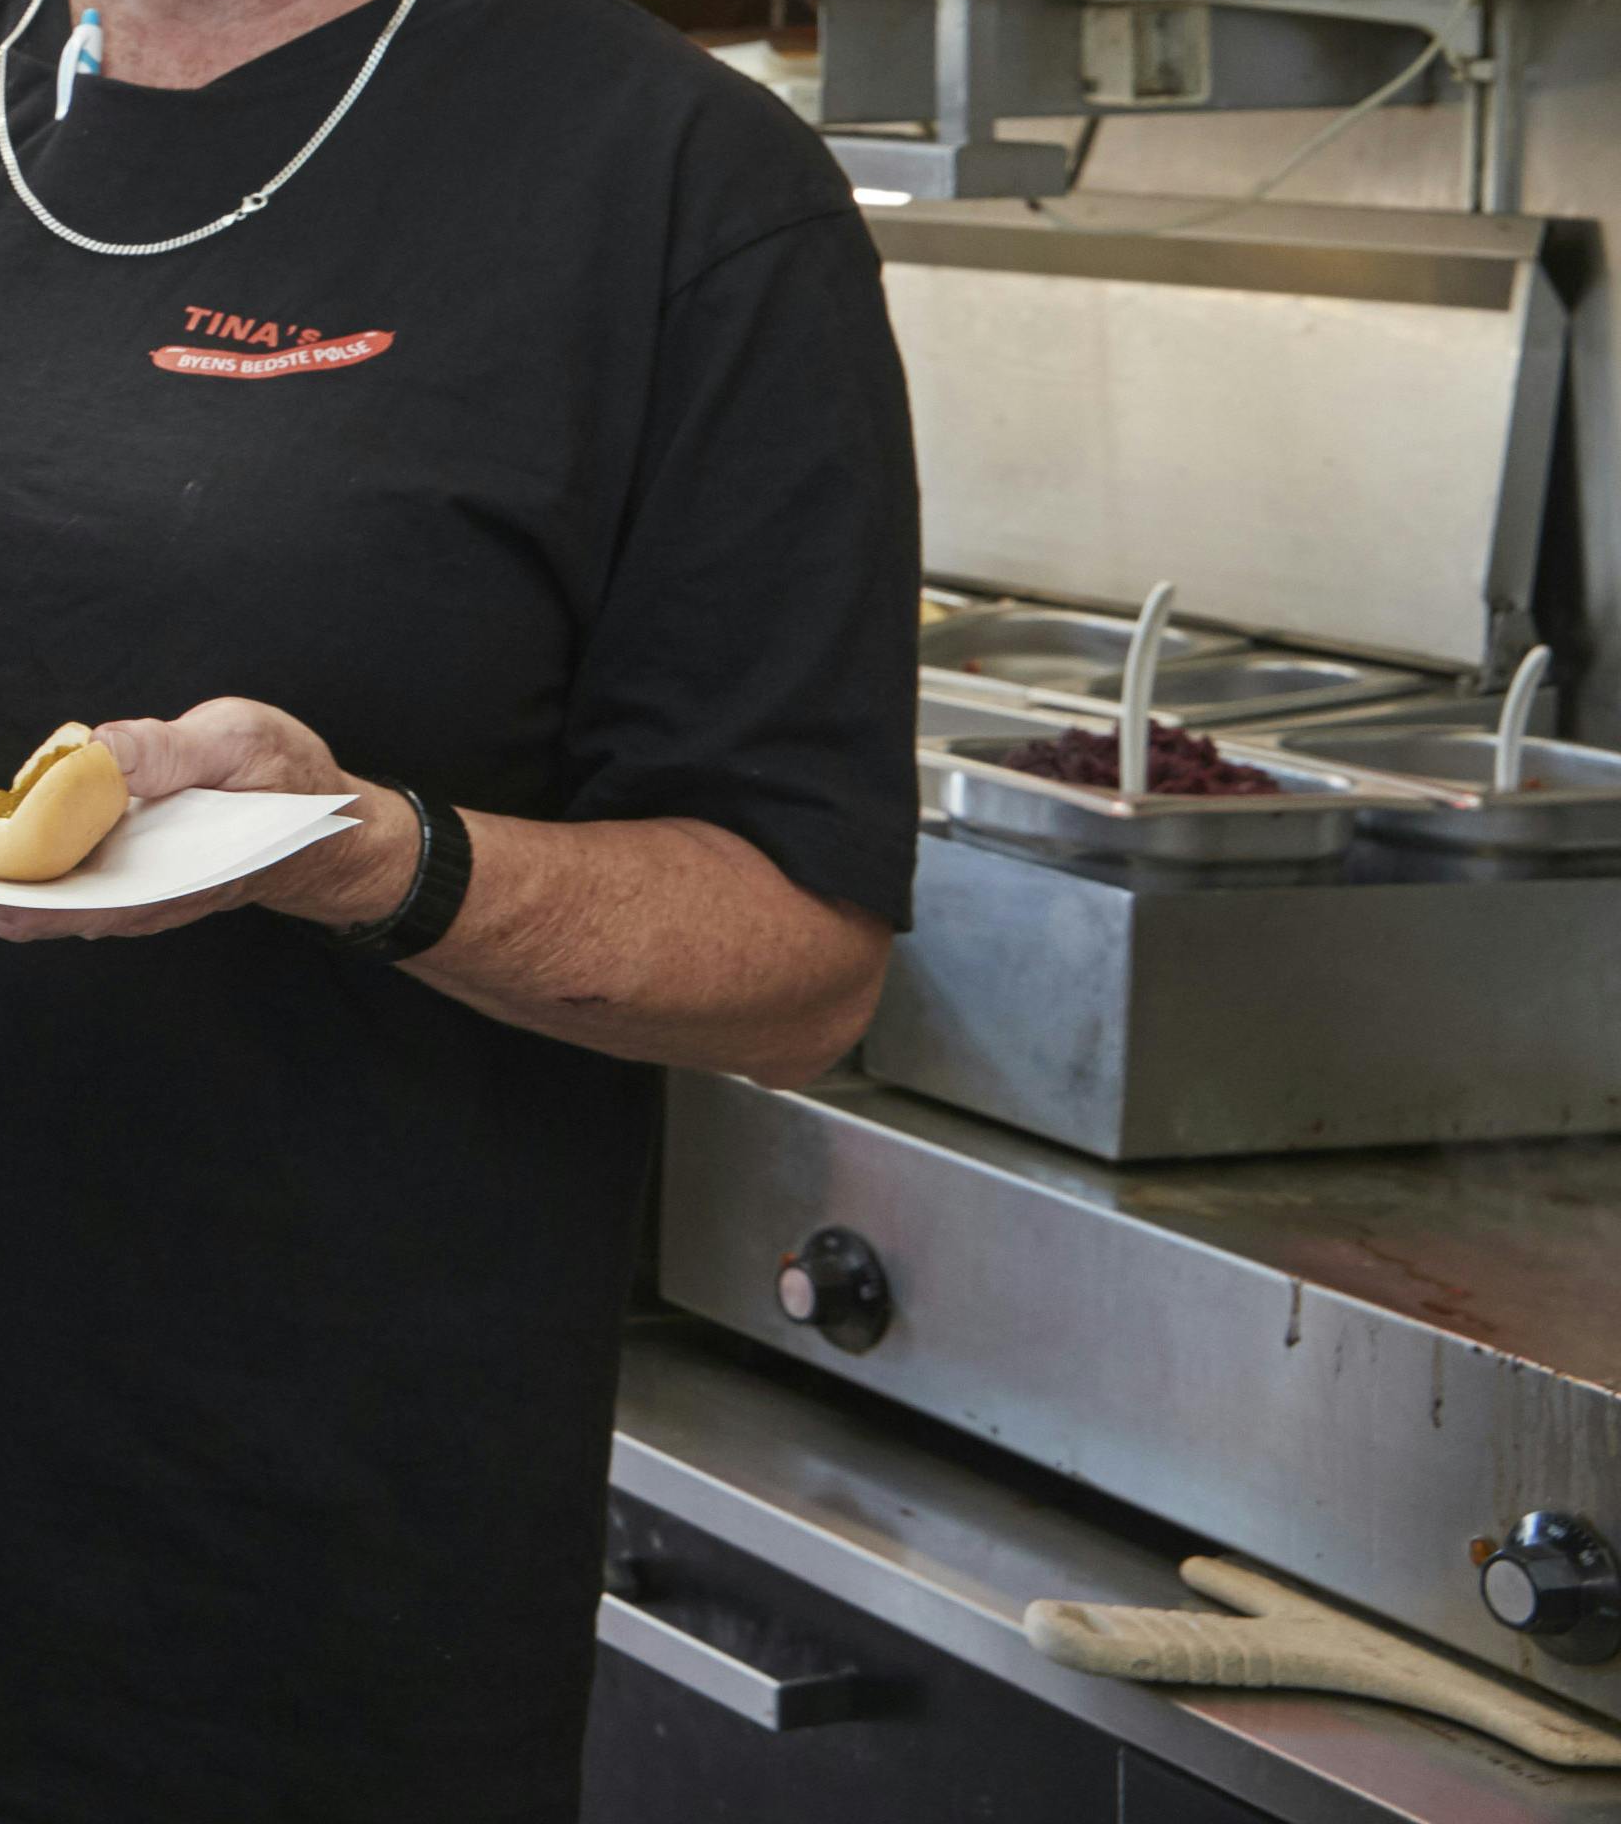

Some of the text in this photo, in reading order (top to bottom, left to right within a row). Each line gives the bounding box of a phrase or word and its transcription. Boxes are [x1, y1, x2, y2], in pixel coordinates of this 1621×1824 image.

[184, 305, 322, 347] TINA'S
[178, 353, 237, 372] BYENS
[240, 350, 311, 374] BEDSTE
